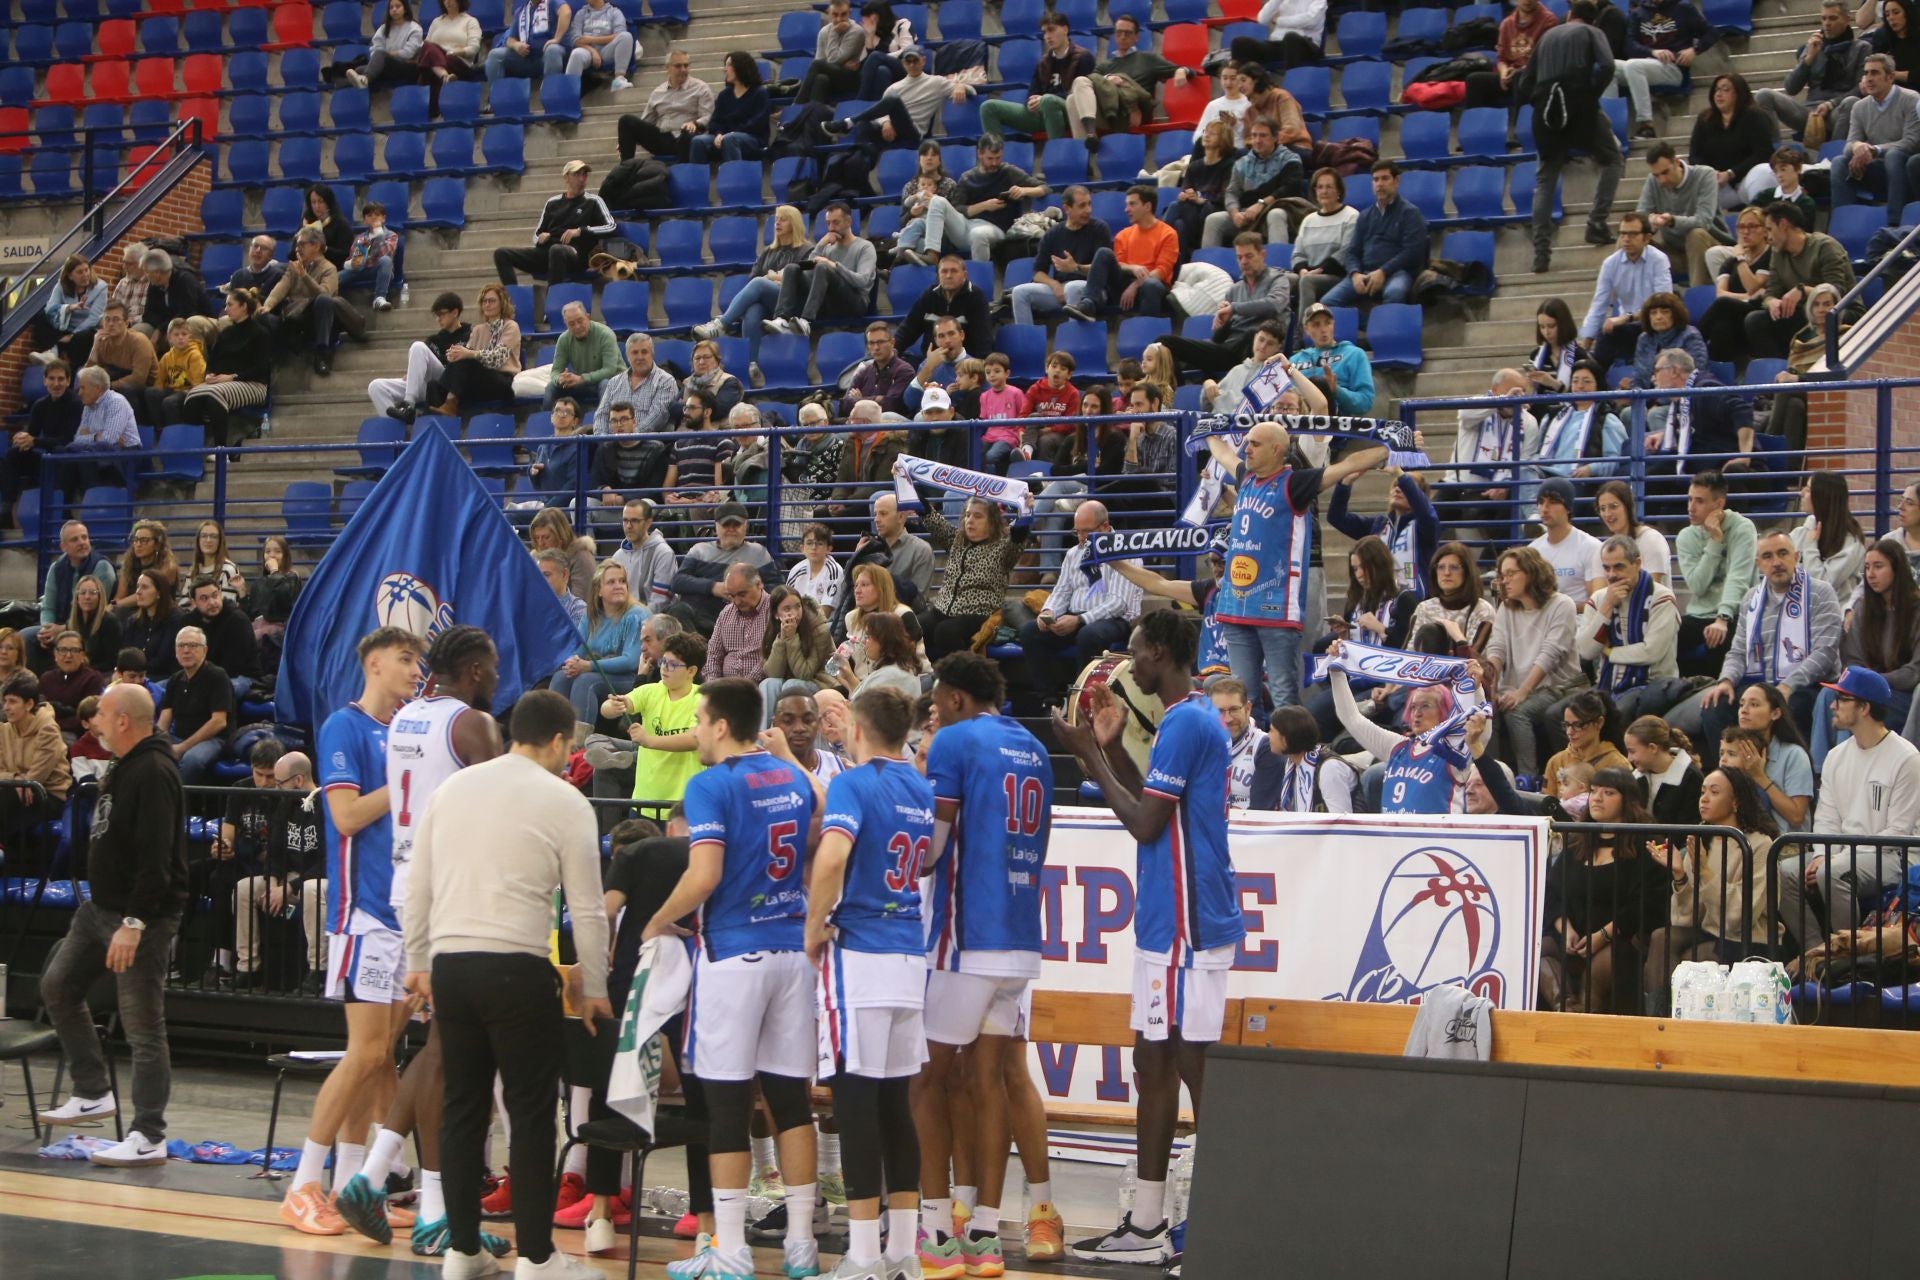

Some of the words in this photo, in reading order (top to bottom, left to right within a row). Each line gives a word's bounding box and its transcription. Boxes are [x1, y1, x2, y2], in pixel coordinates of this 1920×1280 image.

[3, 245, 43, 258] SALIDA
[1240, 514, 1250, 536] 9
[1359, 654, 1403, 673] CB
[398, 769, 412, 827] 1
[1002, 772, 1045, 837] 10
[1392, 781, 1407, 804] 9
[765, 819, 798, 882] 5
[884, 830, 931, 895] 30
